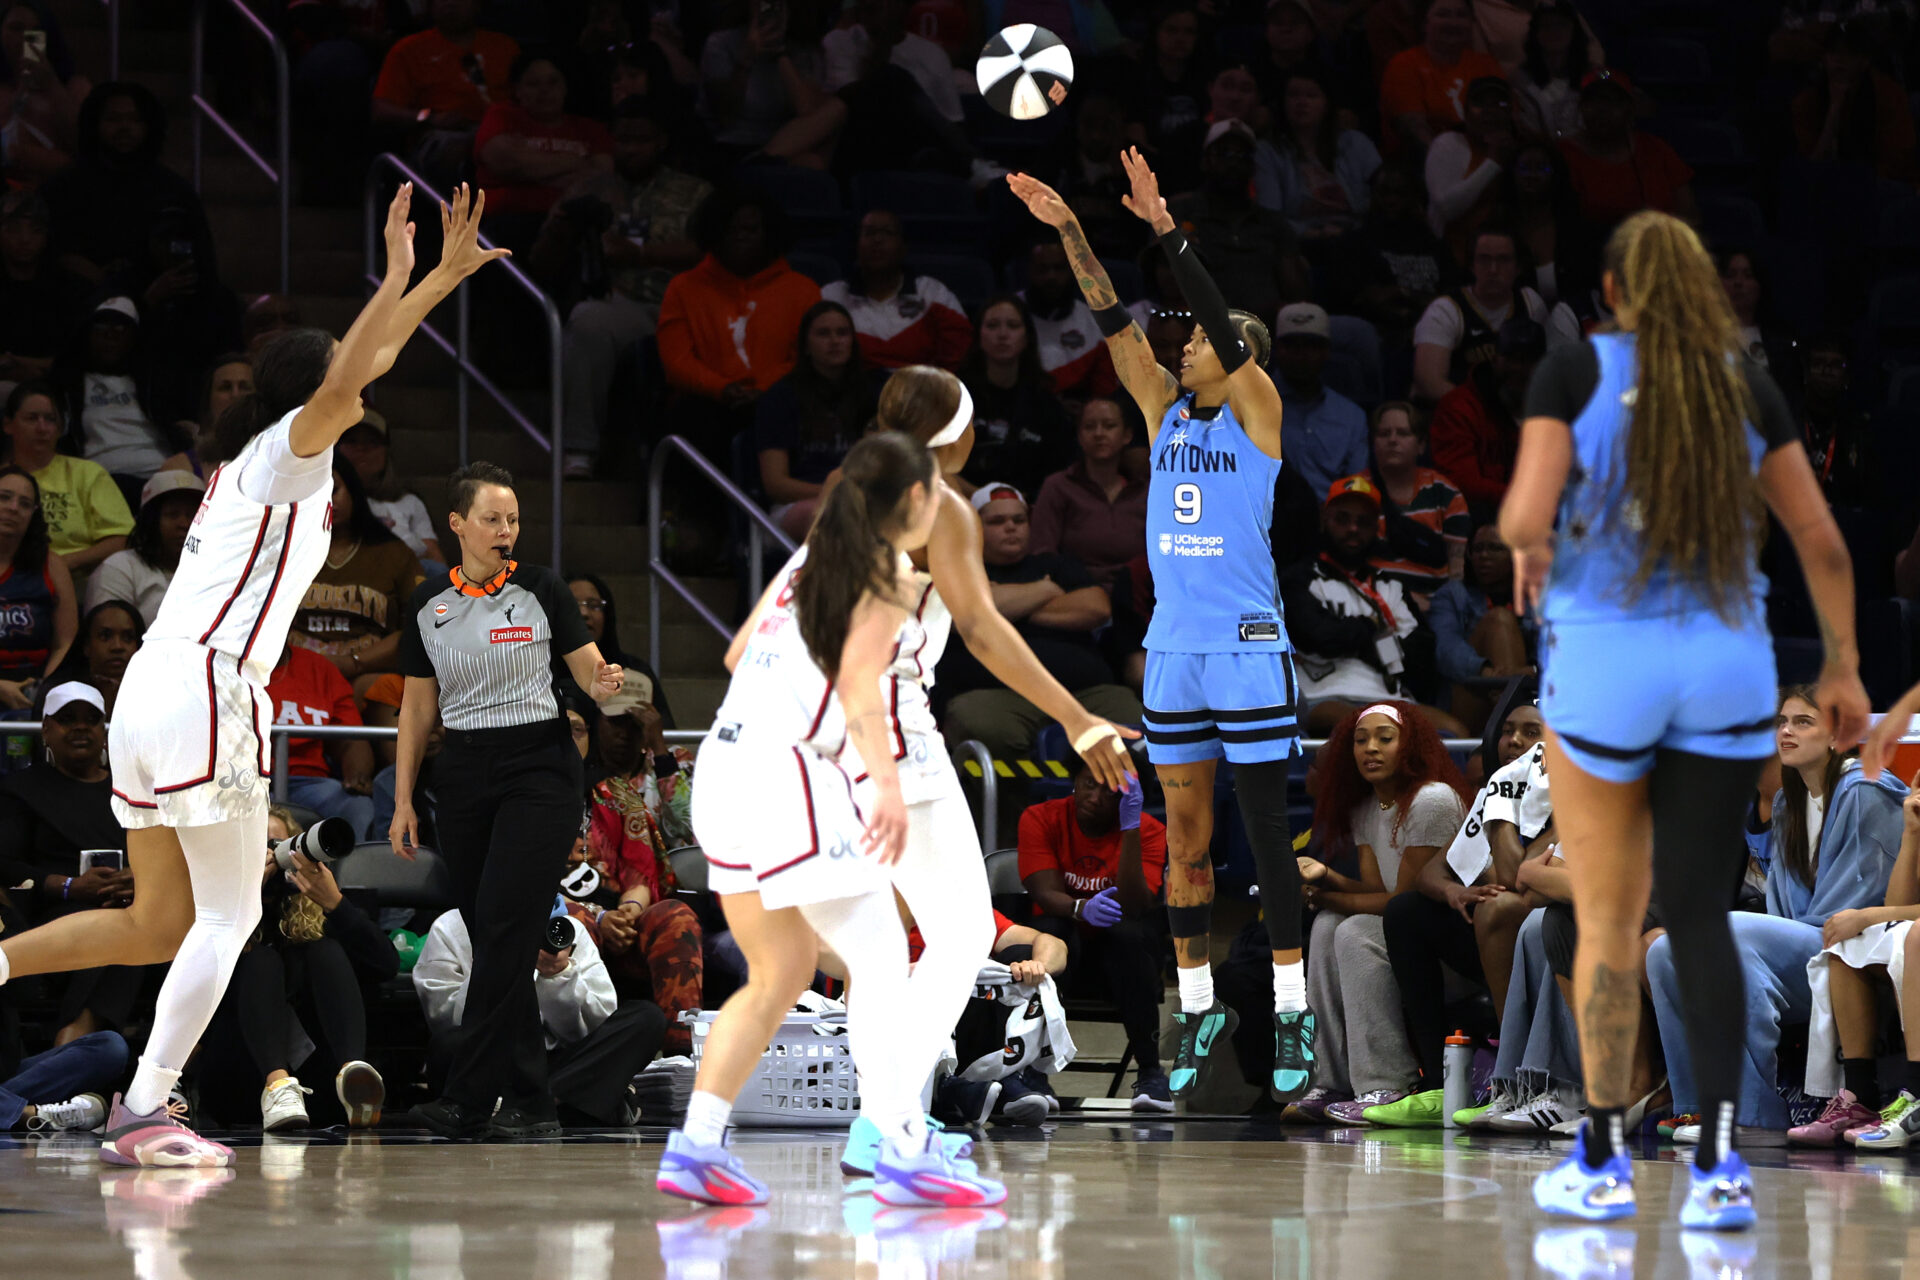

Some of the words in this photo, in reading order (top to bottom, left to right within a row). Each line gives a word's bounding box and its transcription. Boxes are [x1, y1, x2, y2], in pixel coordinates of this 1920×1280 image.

[1173, 482, 1202, 525] 9
[1174, 534, 1224, 547] UChicago
[1174, 545, 1225, 557] Medicine
[491, 630, 532, 641] Emirates
[1064, 871, 1113, 892] mystic
